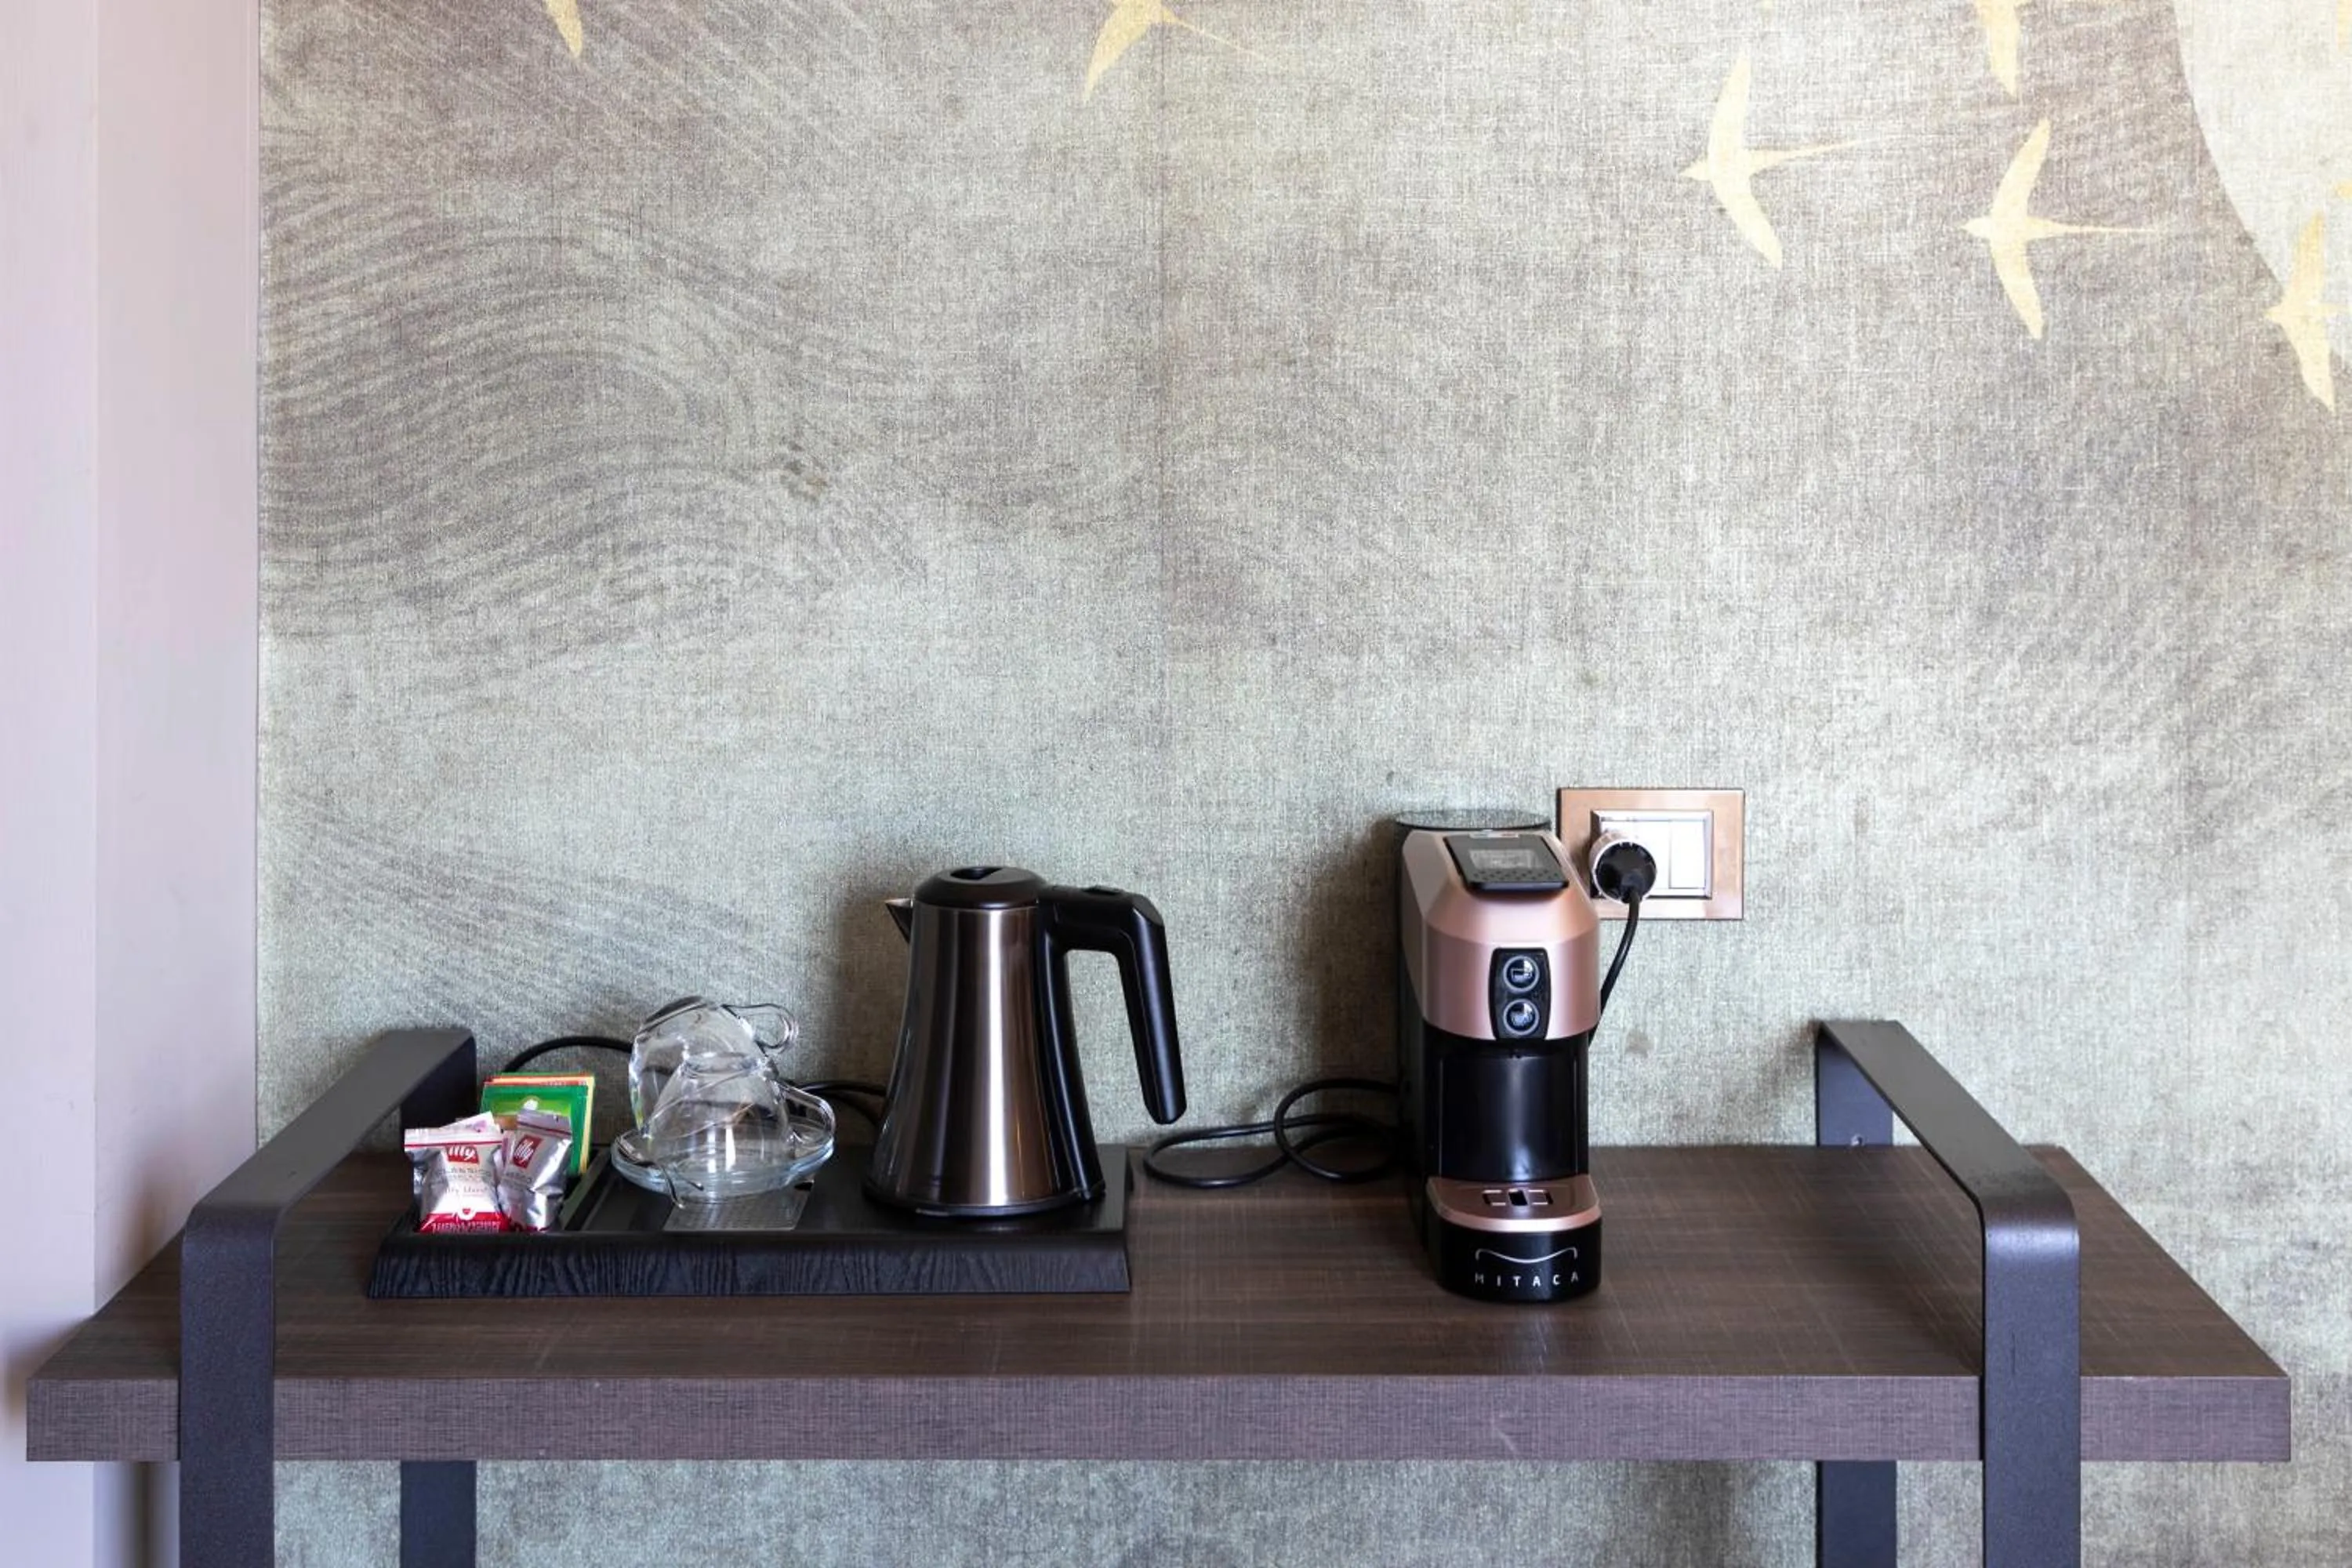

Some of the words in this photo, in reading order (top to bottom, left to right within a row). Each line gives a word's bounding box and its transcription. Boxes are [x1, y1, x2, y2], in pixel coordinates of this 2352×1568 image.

[448, 1145, 477, 1160] illy
[514, 1139, 535, 1163] illy
[1474, 1271, 1579, 1287] MITACA
